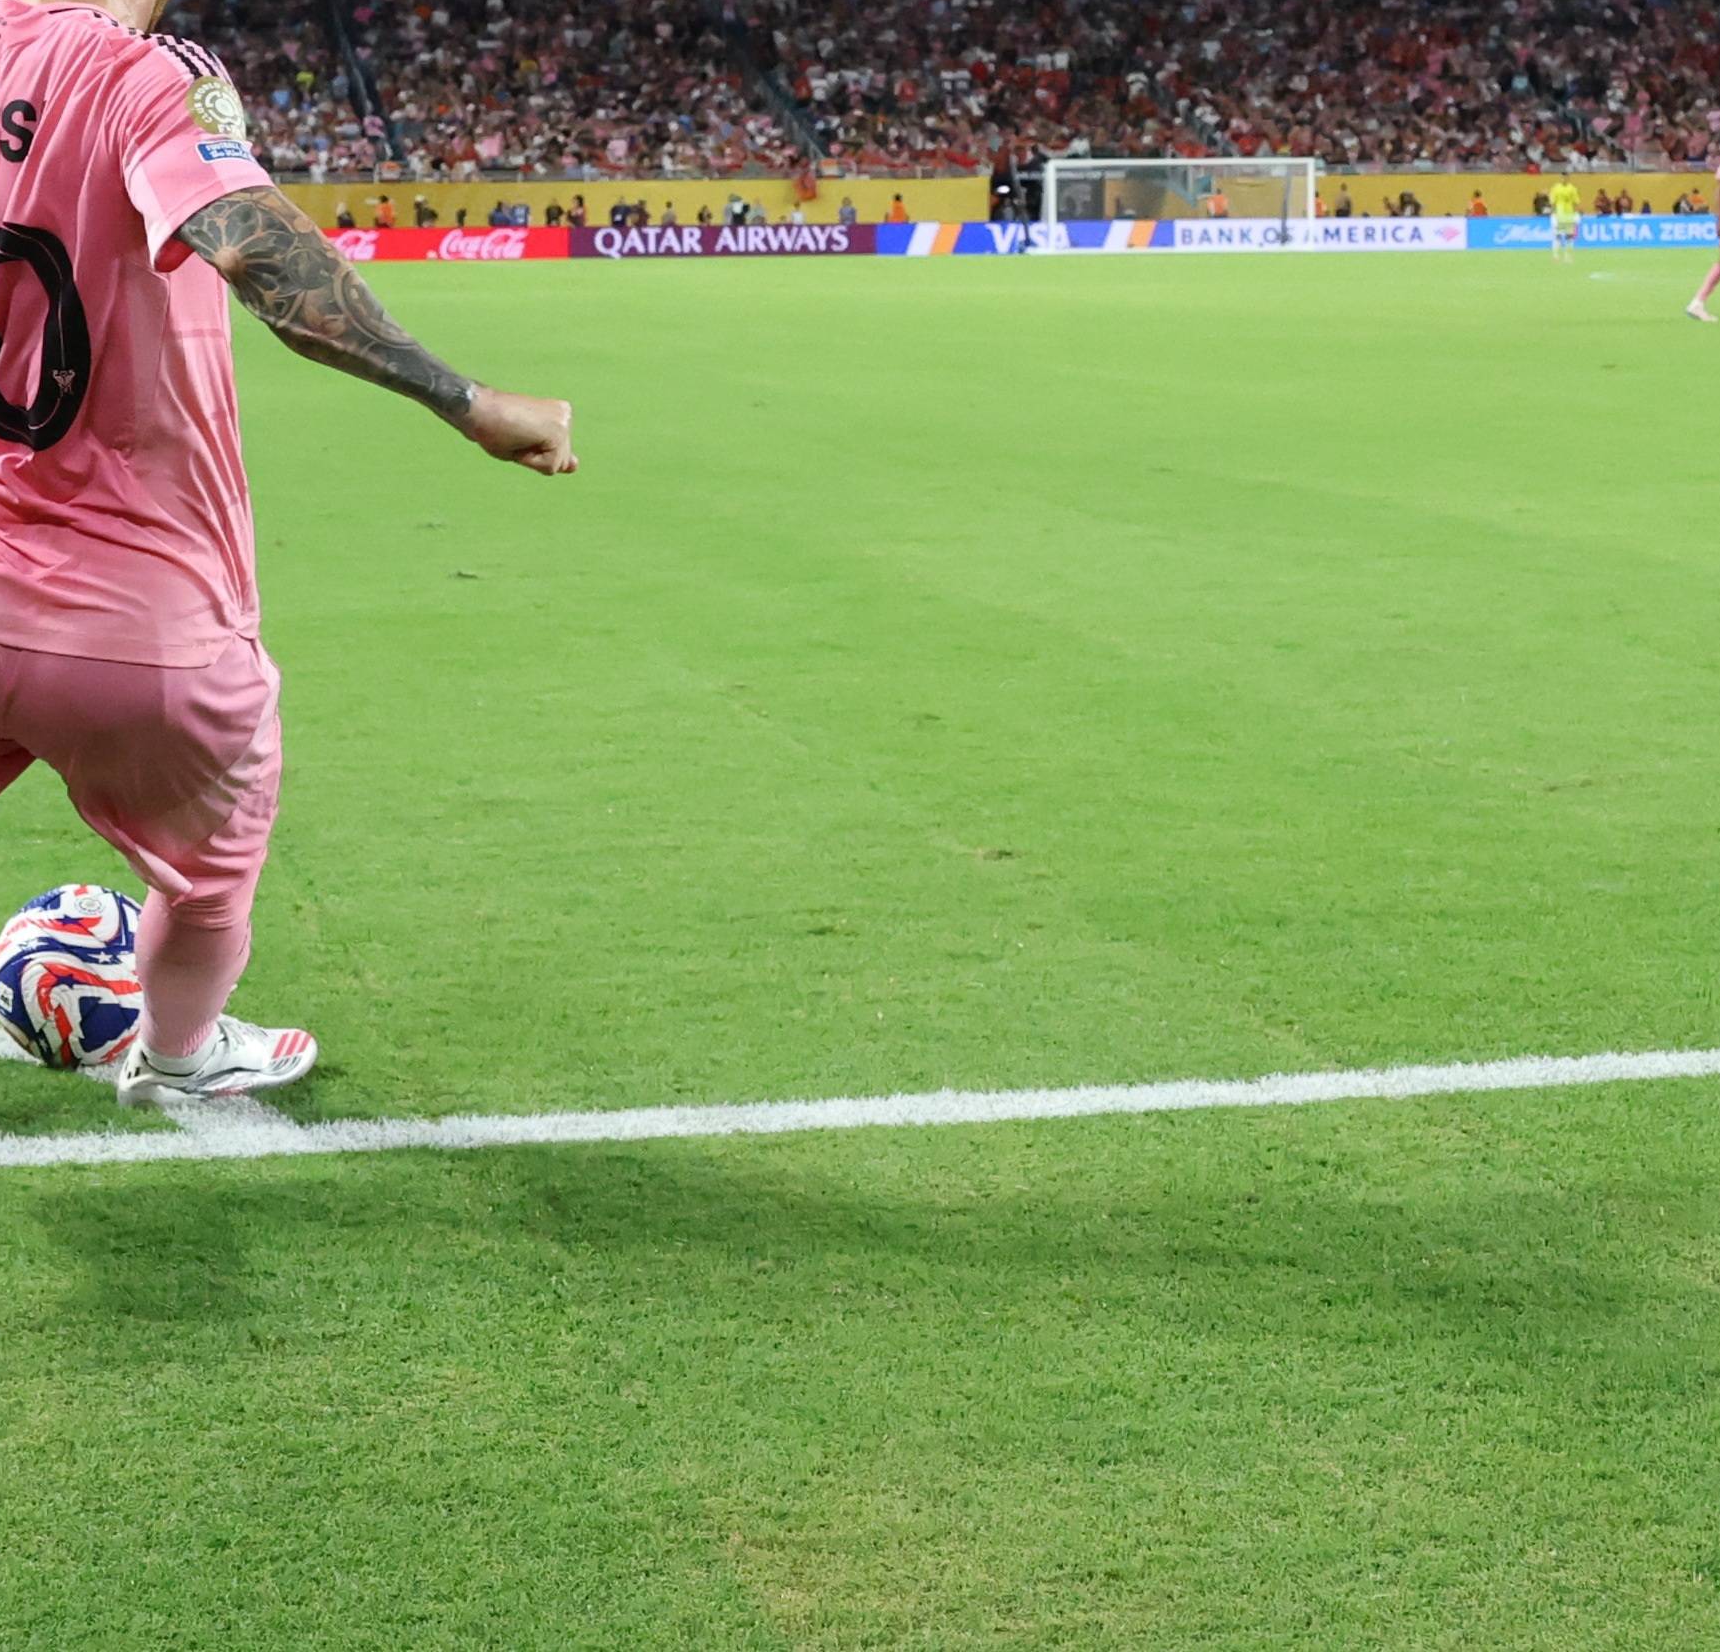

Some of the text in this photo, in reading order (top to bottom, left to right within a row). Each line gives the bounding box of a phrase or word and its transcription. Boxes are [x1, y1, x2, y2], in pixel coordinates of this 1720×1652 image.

[439, 228, 529, 260] Coca-Cola
[593, 225, 850, 259] QATAR AIRWAYS
[1180, 227, 1255, 246] BANK
[1582, 222, 1717, 242] ULTRA ZERO
